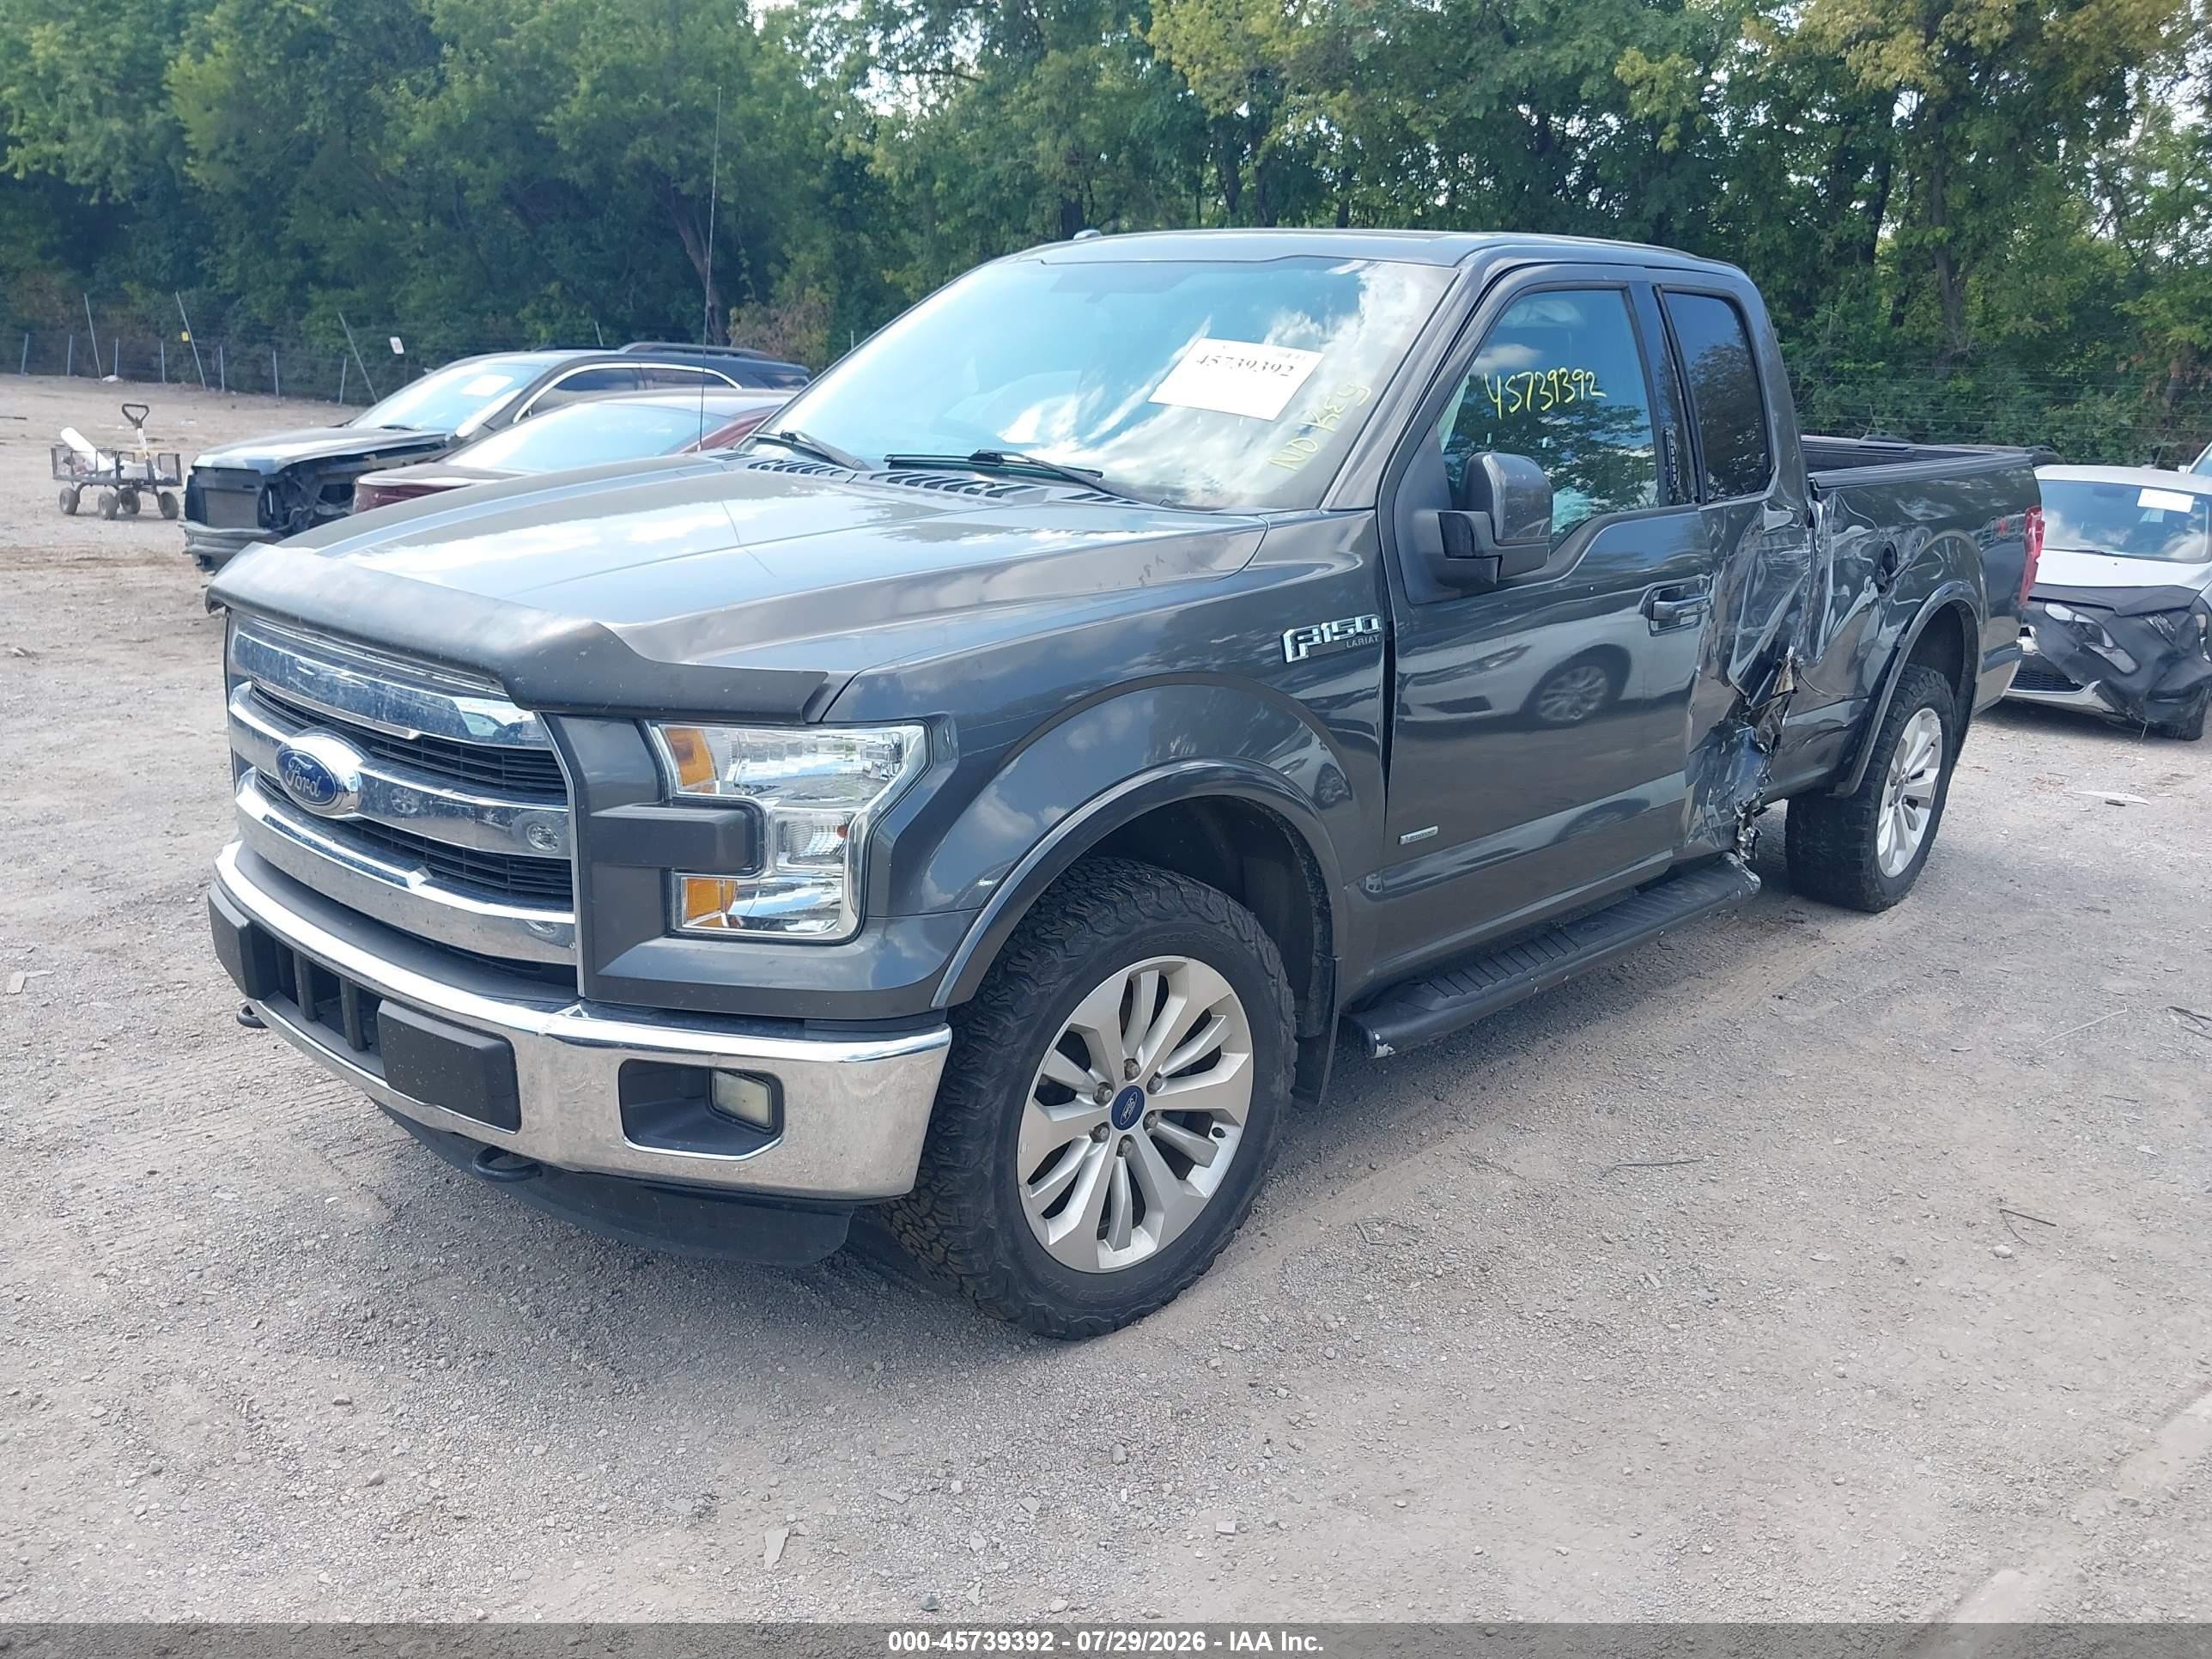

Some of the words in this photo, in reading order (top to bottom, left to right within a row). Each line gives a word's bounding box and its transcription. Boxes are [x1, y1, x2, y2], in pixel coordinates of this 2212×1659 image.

[1485, 367, 1607, 420] 45739392
[1346, 635, 1380, 648] LARIAT
[285, 756, 322, 798] Ford
